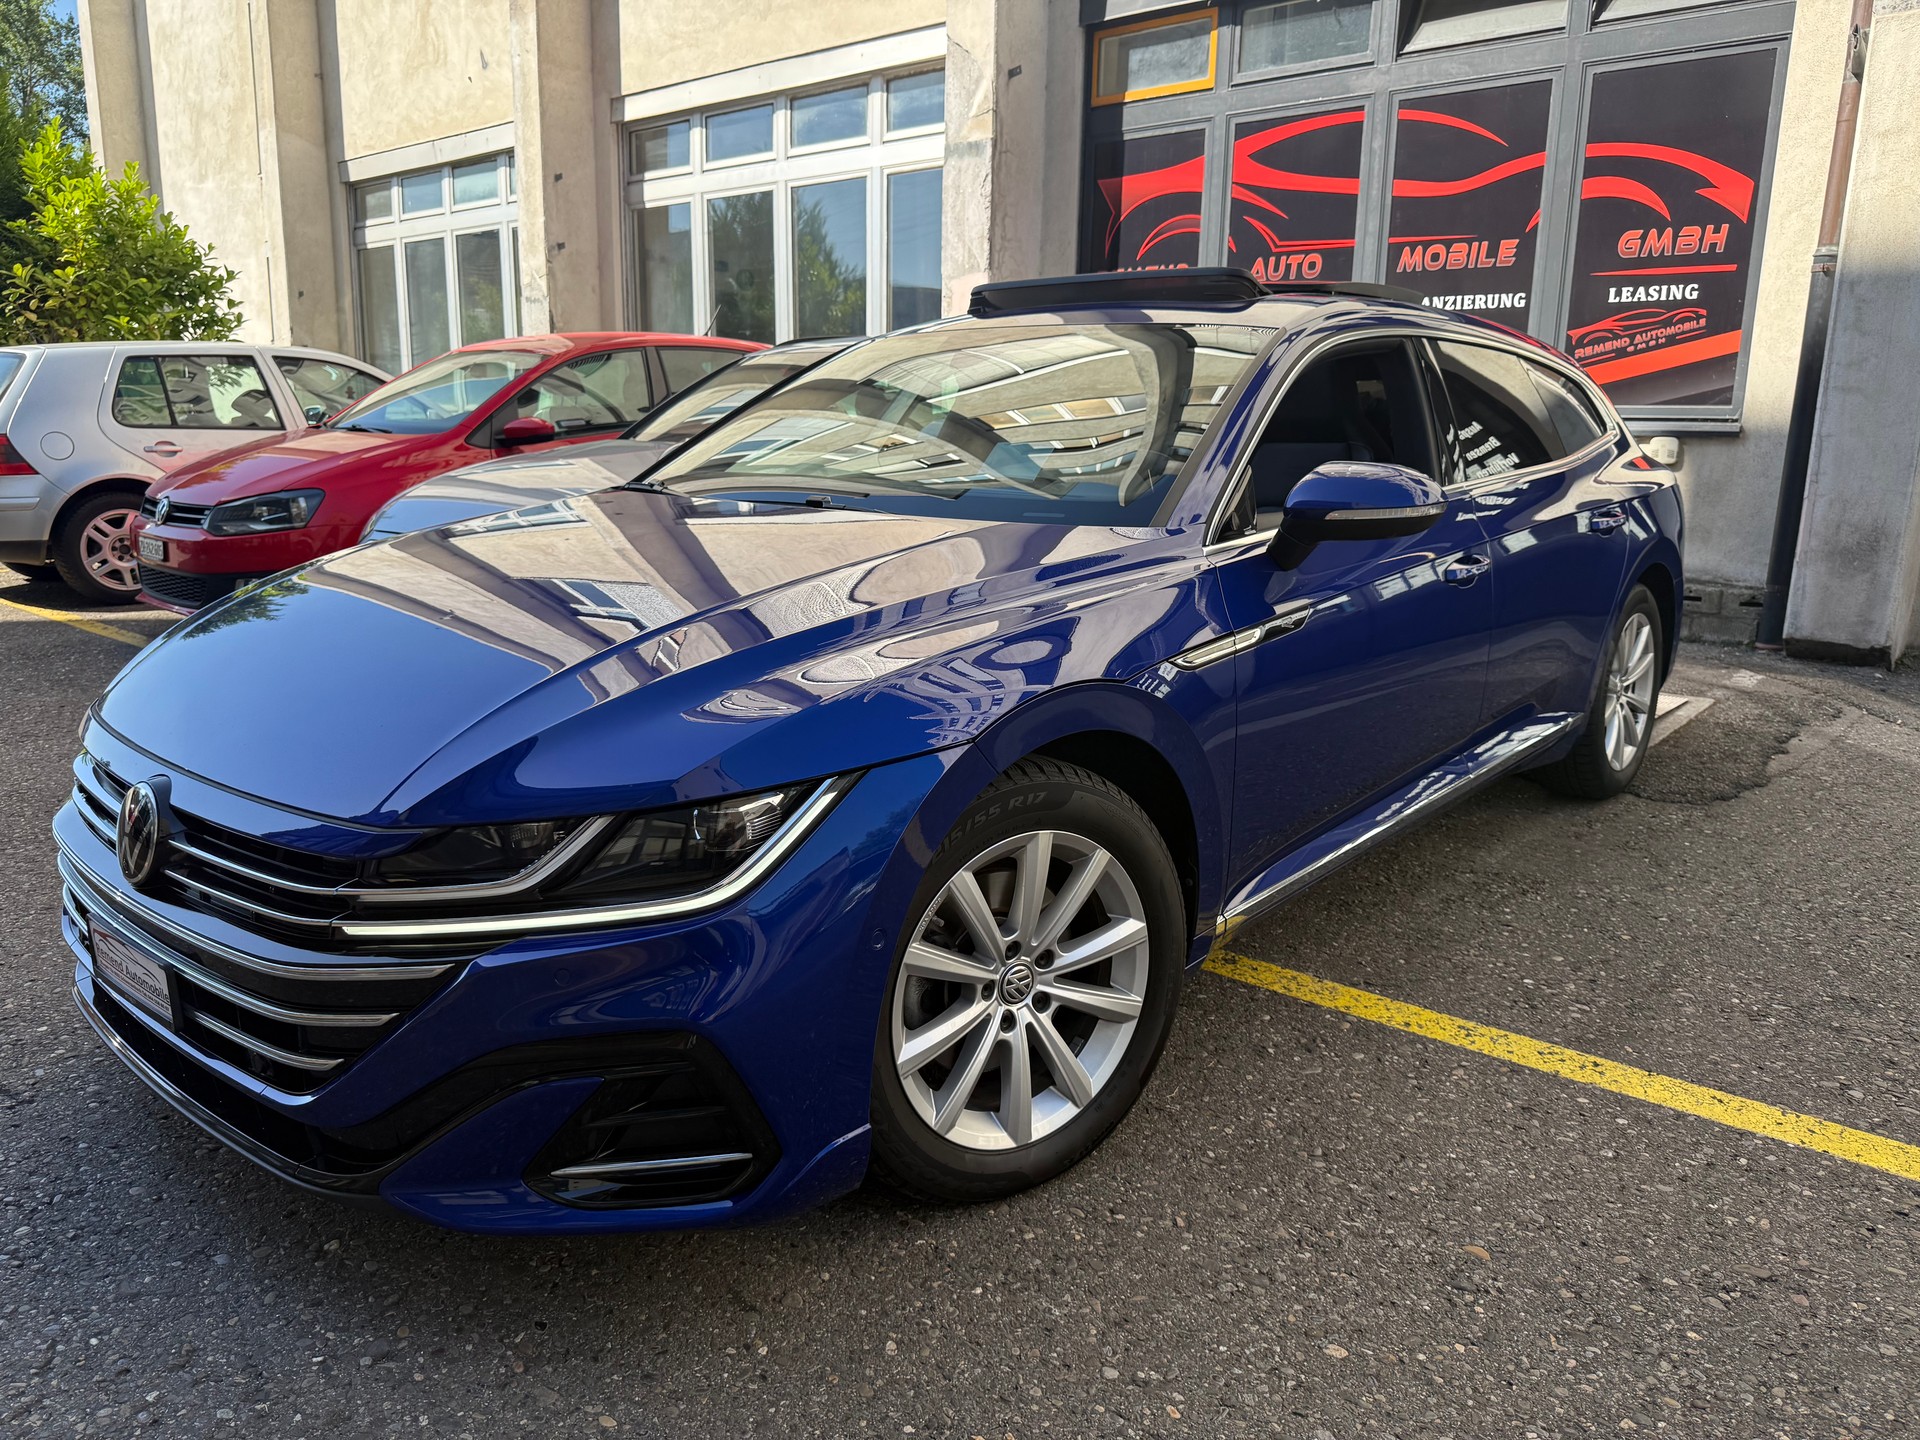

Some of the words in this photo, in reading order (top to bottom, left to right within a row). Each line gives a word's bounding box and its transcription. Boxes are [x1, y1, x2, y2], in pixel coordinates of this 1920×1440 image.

[1251, 253, 1323, 282] AUTO
[1396, 238, 1520, 273] MOBILE
[1617, 224, 1730, 259] GMBH
[1608, 284, 1699, 303] LEASING
[1574, 338, 1630, 359] REMEND
[1633, 317, 1707, 344] AUTOMOBILE
[125, 966, 169, 1002] Automobile
